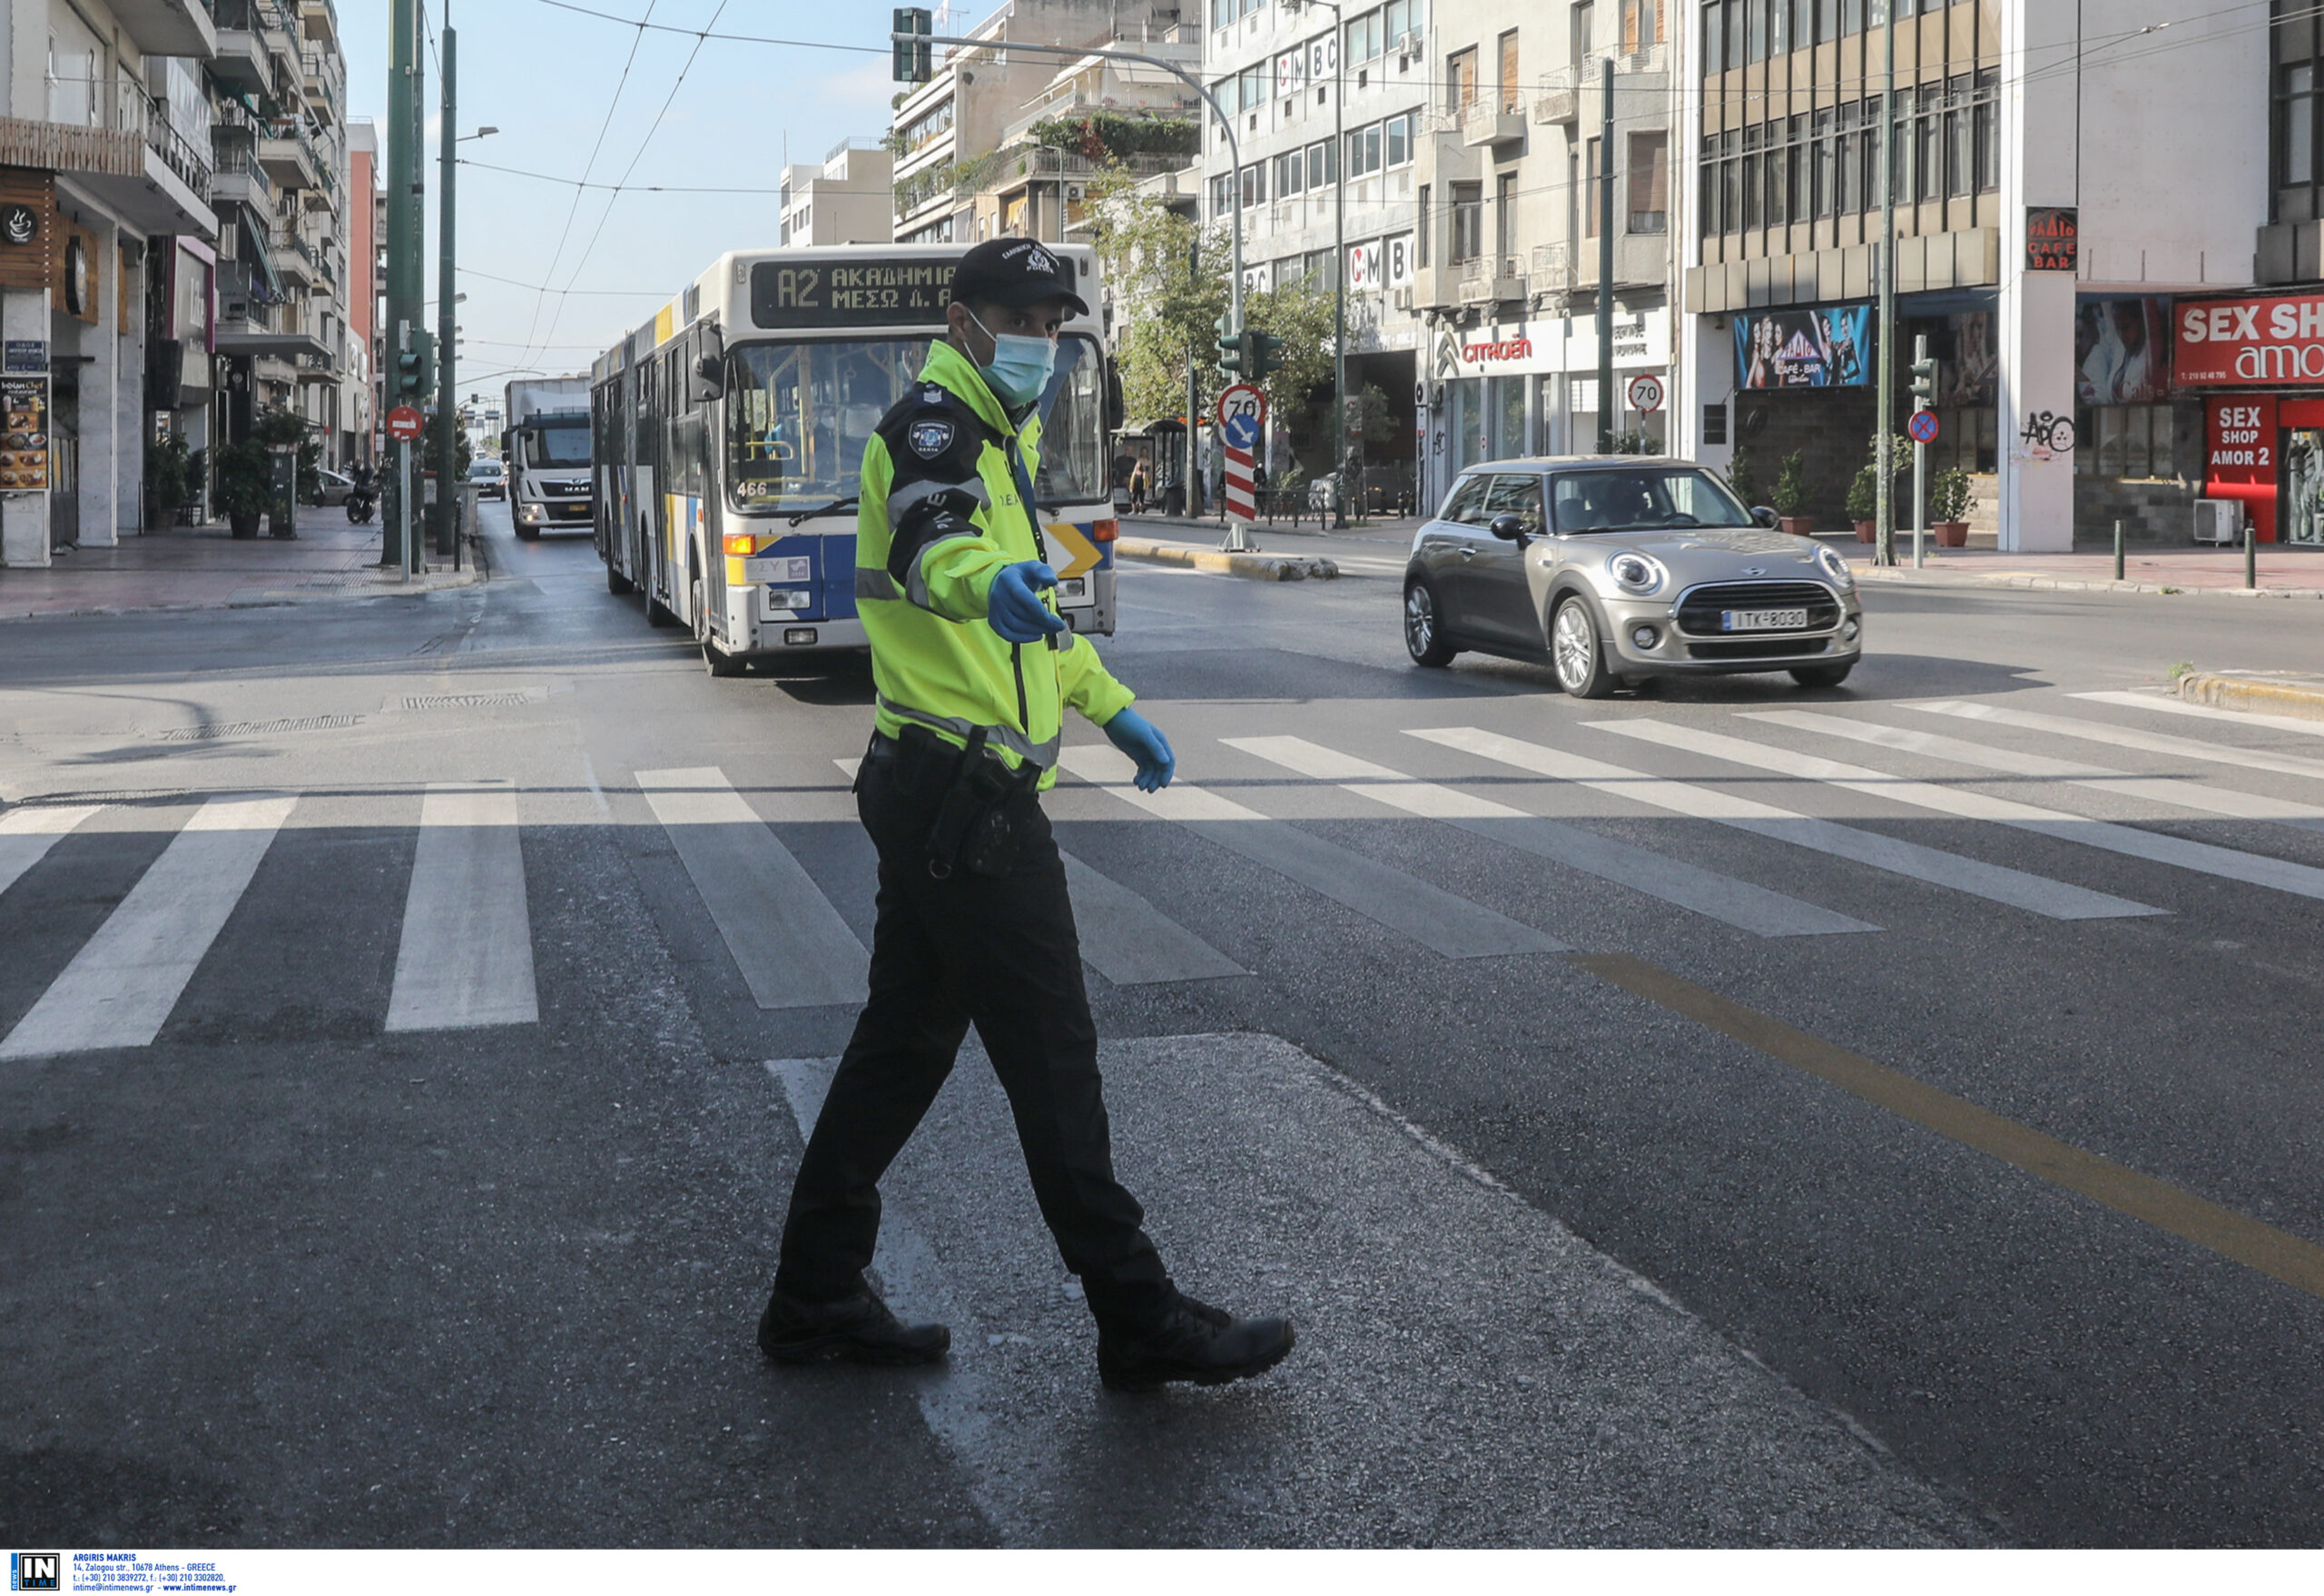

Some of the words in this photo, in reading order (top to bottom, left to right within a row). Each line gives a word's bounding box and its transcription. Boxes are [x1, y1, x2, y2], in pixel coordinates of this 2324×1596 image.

[2028, 241, 2076, 254] CAFE
[2034, 256, 2069, 269] BAR
[832, 290, 899, 309] ΜΕΣΩ
[2182, 305, 2260, 343] SEX
[1804, 364, 1821, 373] BAR
[1637, 387, 1657, 400] 70
[1228, 400, 1256, 419] 70
[2220, 407, 2260, 428] SEX
[2221, 430, 2259, 444] SHOP
[2211, 450, 2254, 465] AMOR
[2258, 448, 2270, 465] 2
[737, 482, 767, 497] 466
